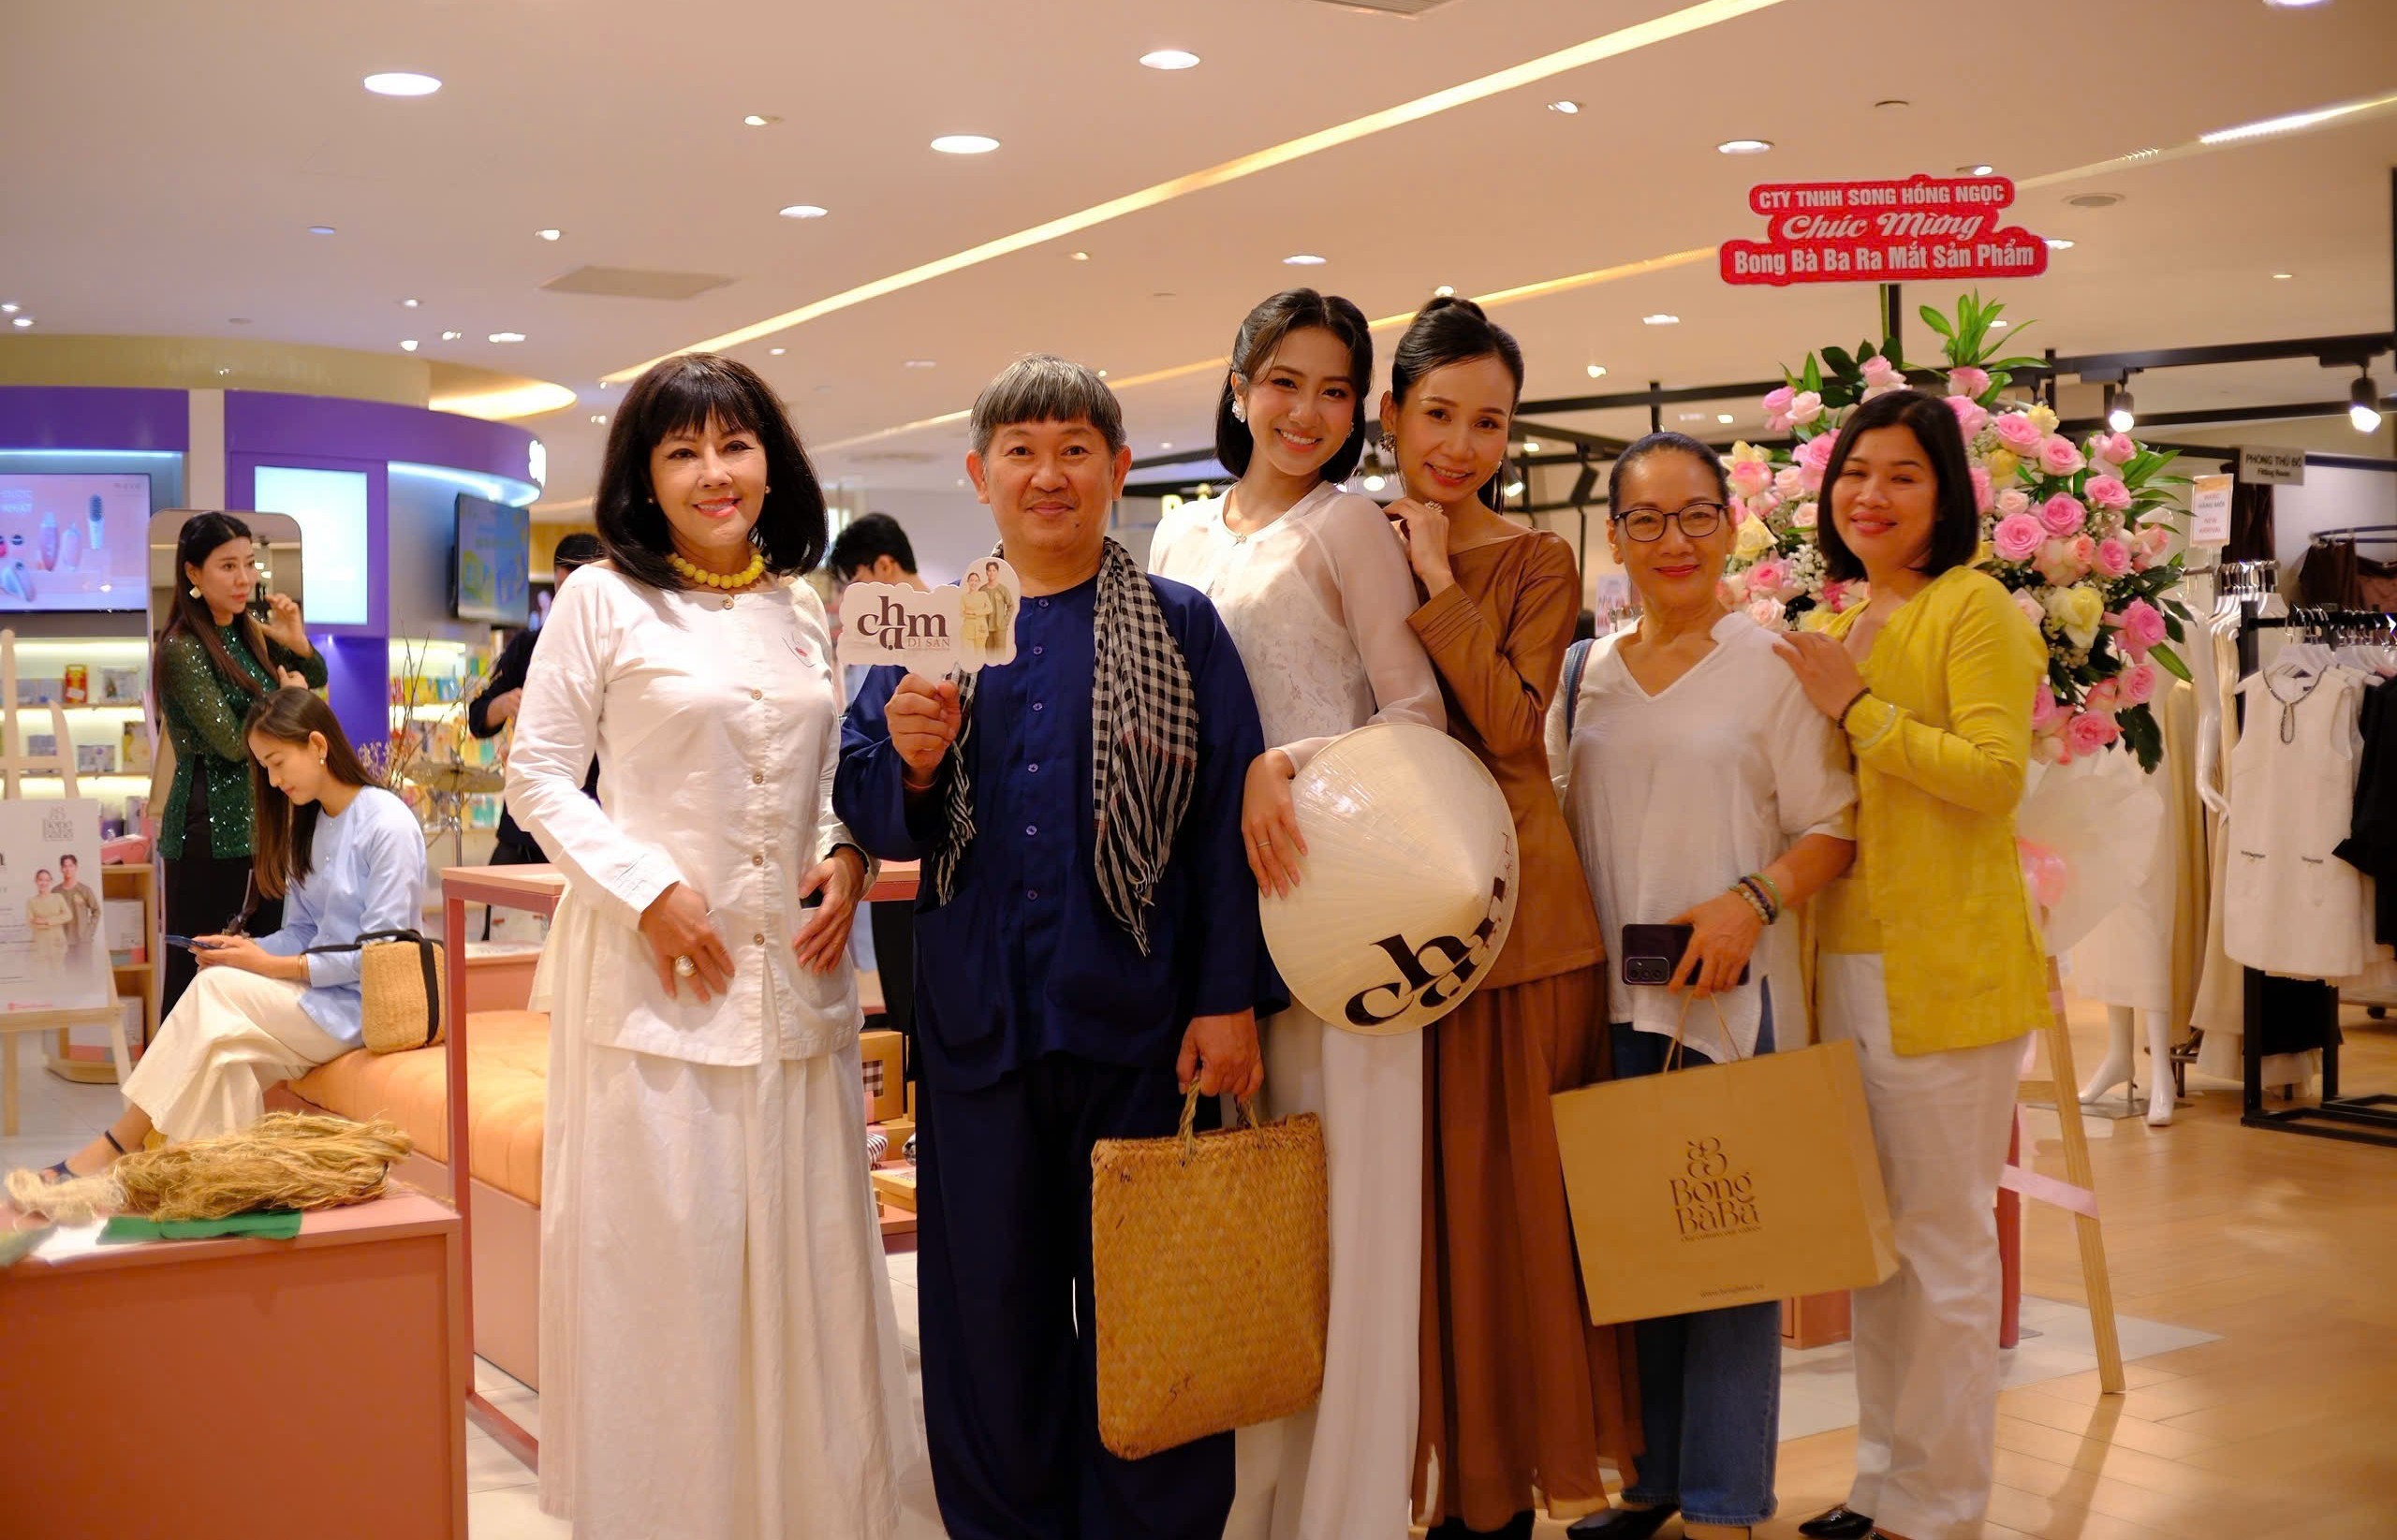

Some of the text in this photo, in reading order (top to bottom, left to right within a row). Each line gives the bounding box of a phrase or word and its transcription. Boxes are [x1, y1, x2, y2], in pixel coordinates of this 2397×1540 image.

[1758, 181, 2006, 209] CTY TNHH SONG HỒNG NGỌC
[1782, 212, 1984, 241] Chúc Mừng
[1734, 238, 2036, 276] Bong Bà Ba Ra Mắt Sản Phẩm
